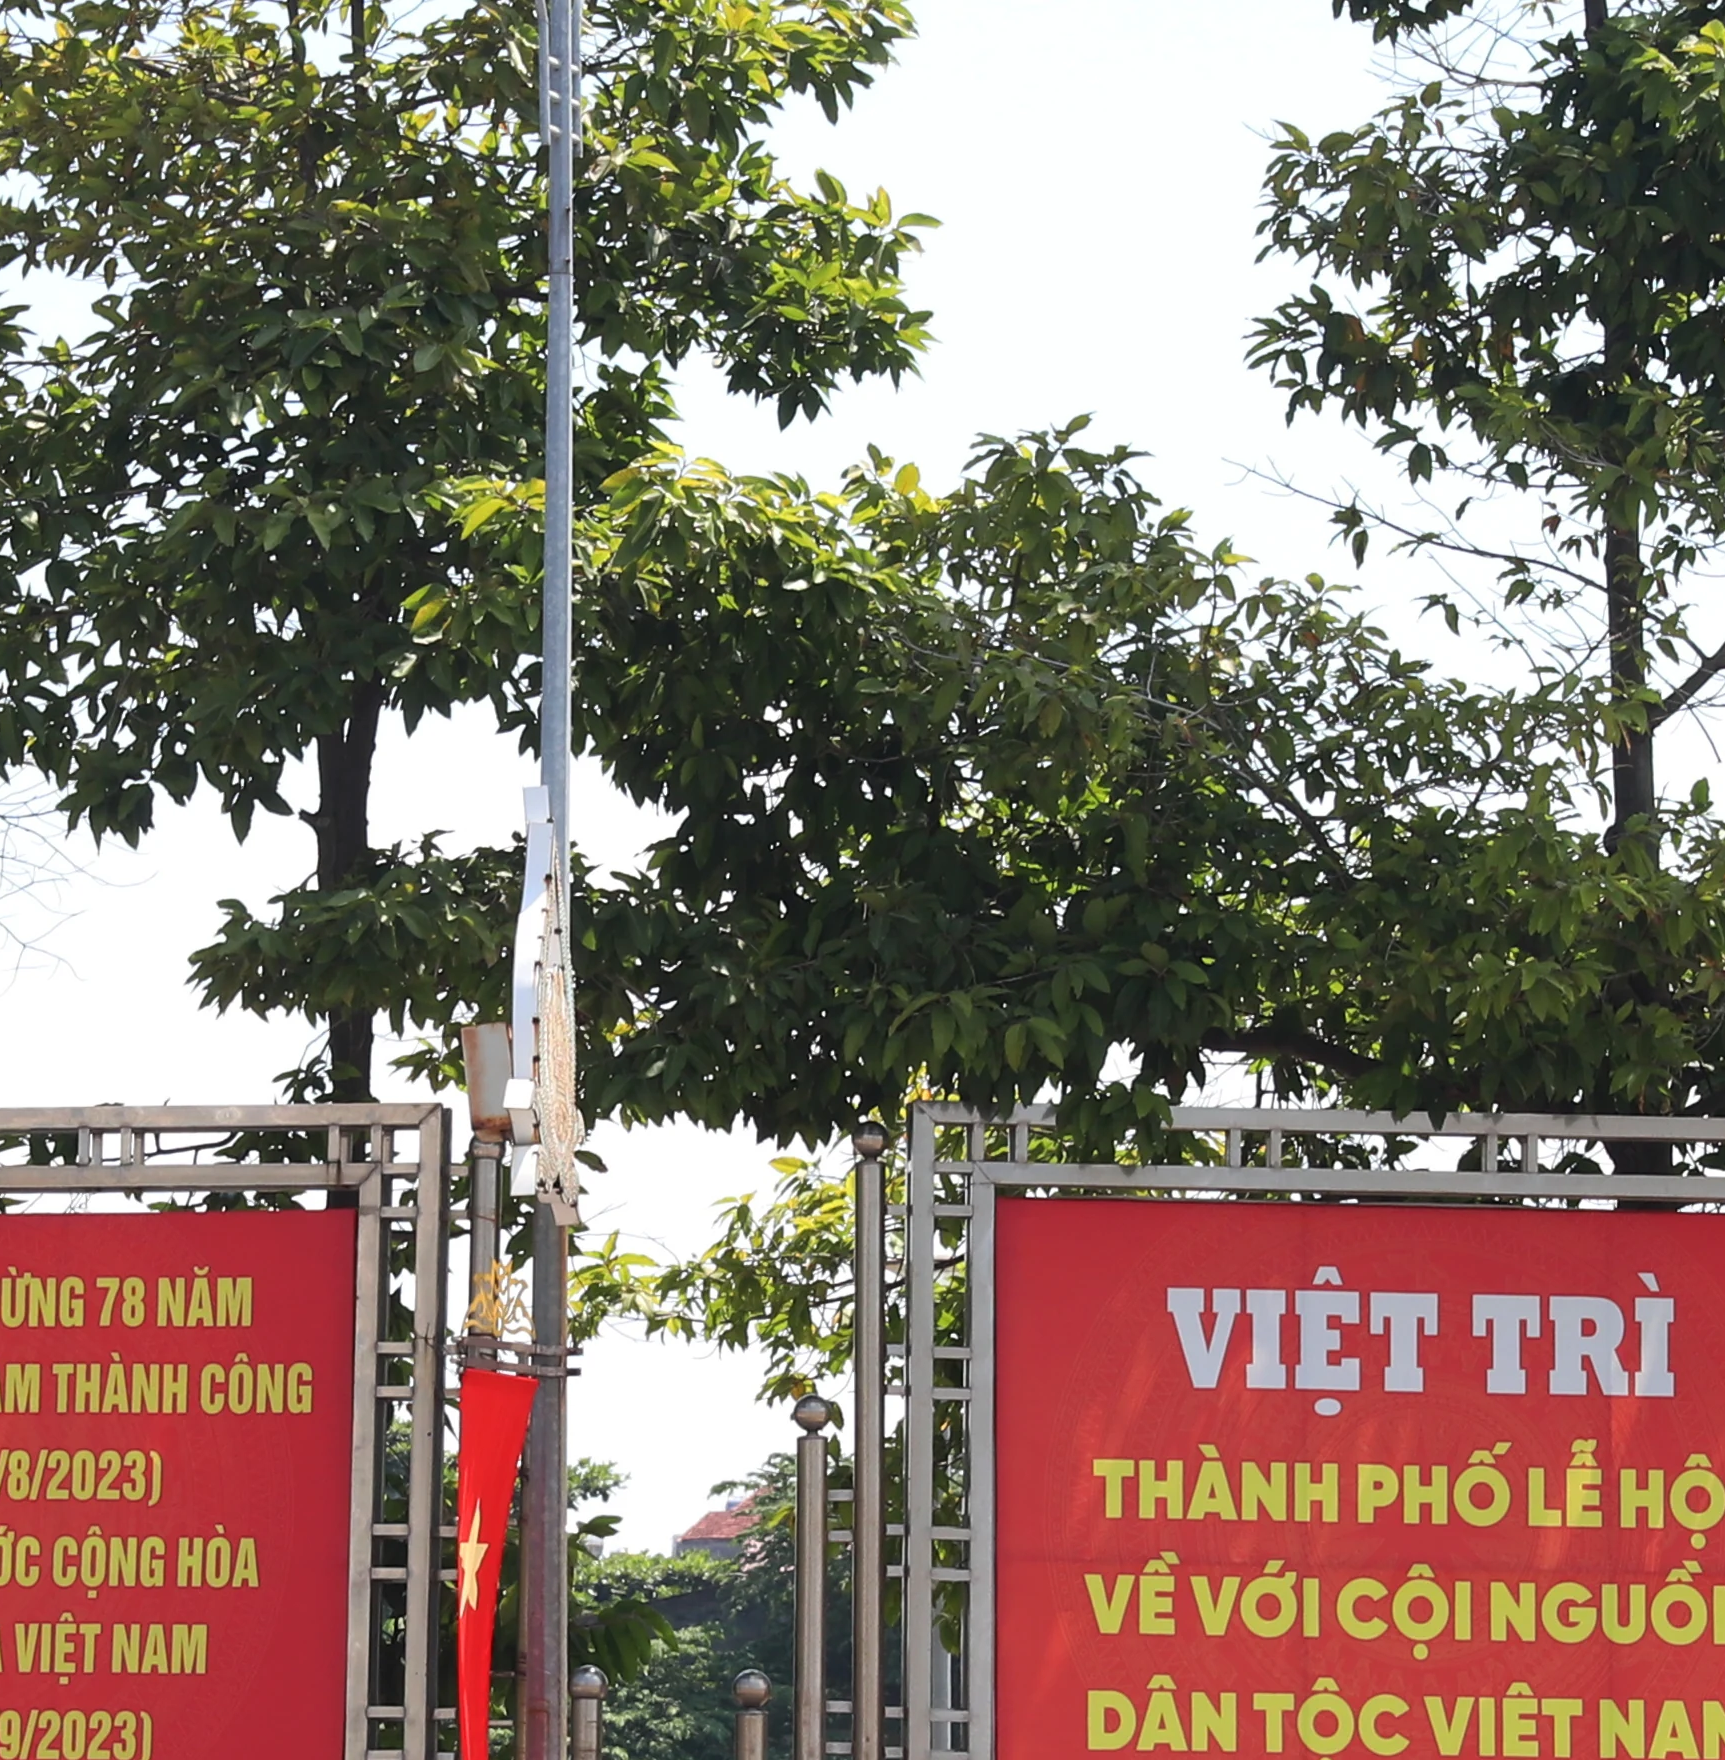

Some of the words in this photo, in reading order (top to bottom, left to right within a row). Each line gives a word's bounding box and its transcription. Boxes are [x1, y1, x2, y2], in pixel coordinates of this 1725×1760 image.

[97, 1277, 144, 1326] 78
[158, 1268, 251, 1326] NĂM
[1167, 1267, 1438, 1415] VIỆT
[1473, 1273, 1674, 1396] TRÌ
[53, 1353, 187, 1413] THÀNH
[201, 1353, 312, 1414] CÔNG
[1093, 1444, 1338, 1522] THÀNH
[1358, 1442, 1511, 1526] PHỐ
[1528, 1439, 1602, 1527] LỄ
[53, 1526, 165, 1598] CỘNG
[178, 1525, 258, 1587] HÒA
[1085, 1552, 1179, 1635] VỀ
[1191, 1560, 1319, 1637] VỚI
[1337, 1564, 1471, 1660] CỘI
[15, 1613, 101, 1684] VIỆT
[112, 1624, 207, 1673] NAM
[1088, 1675, 1237, 1752] DÂN
